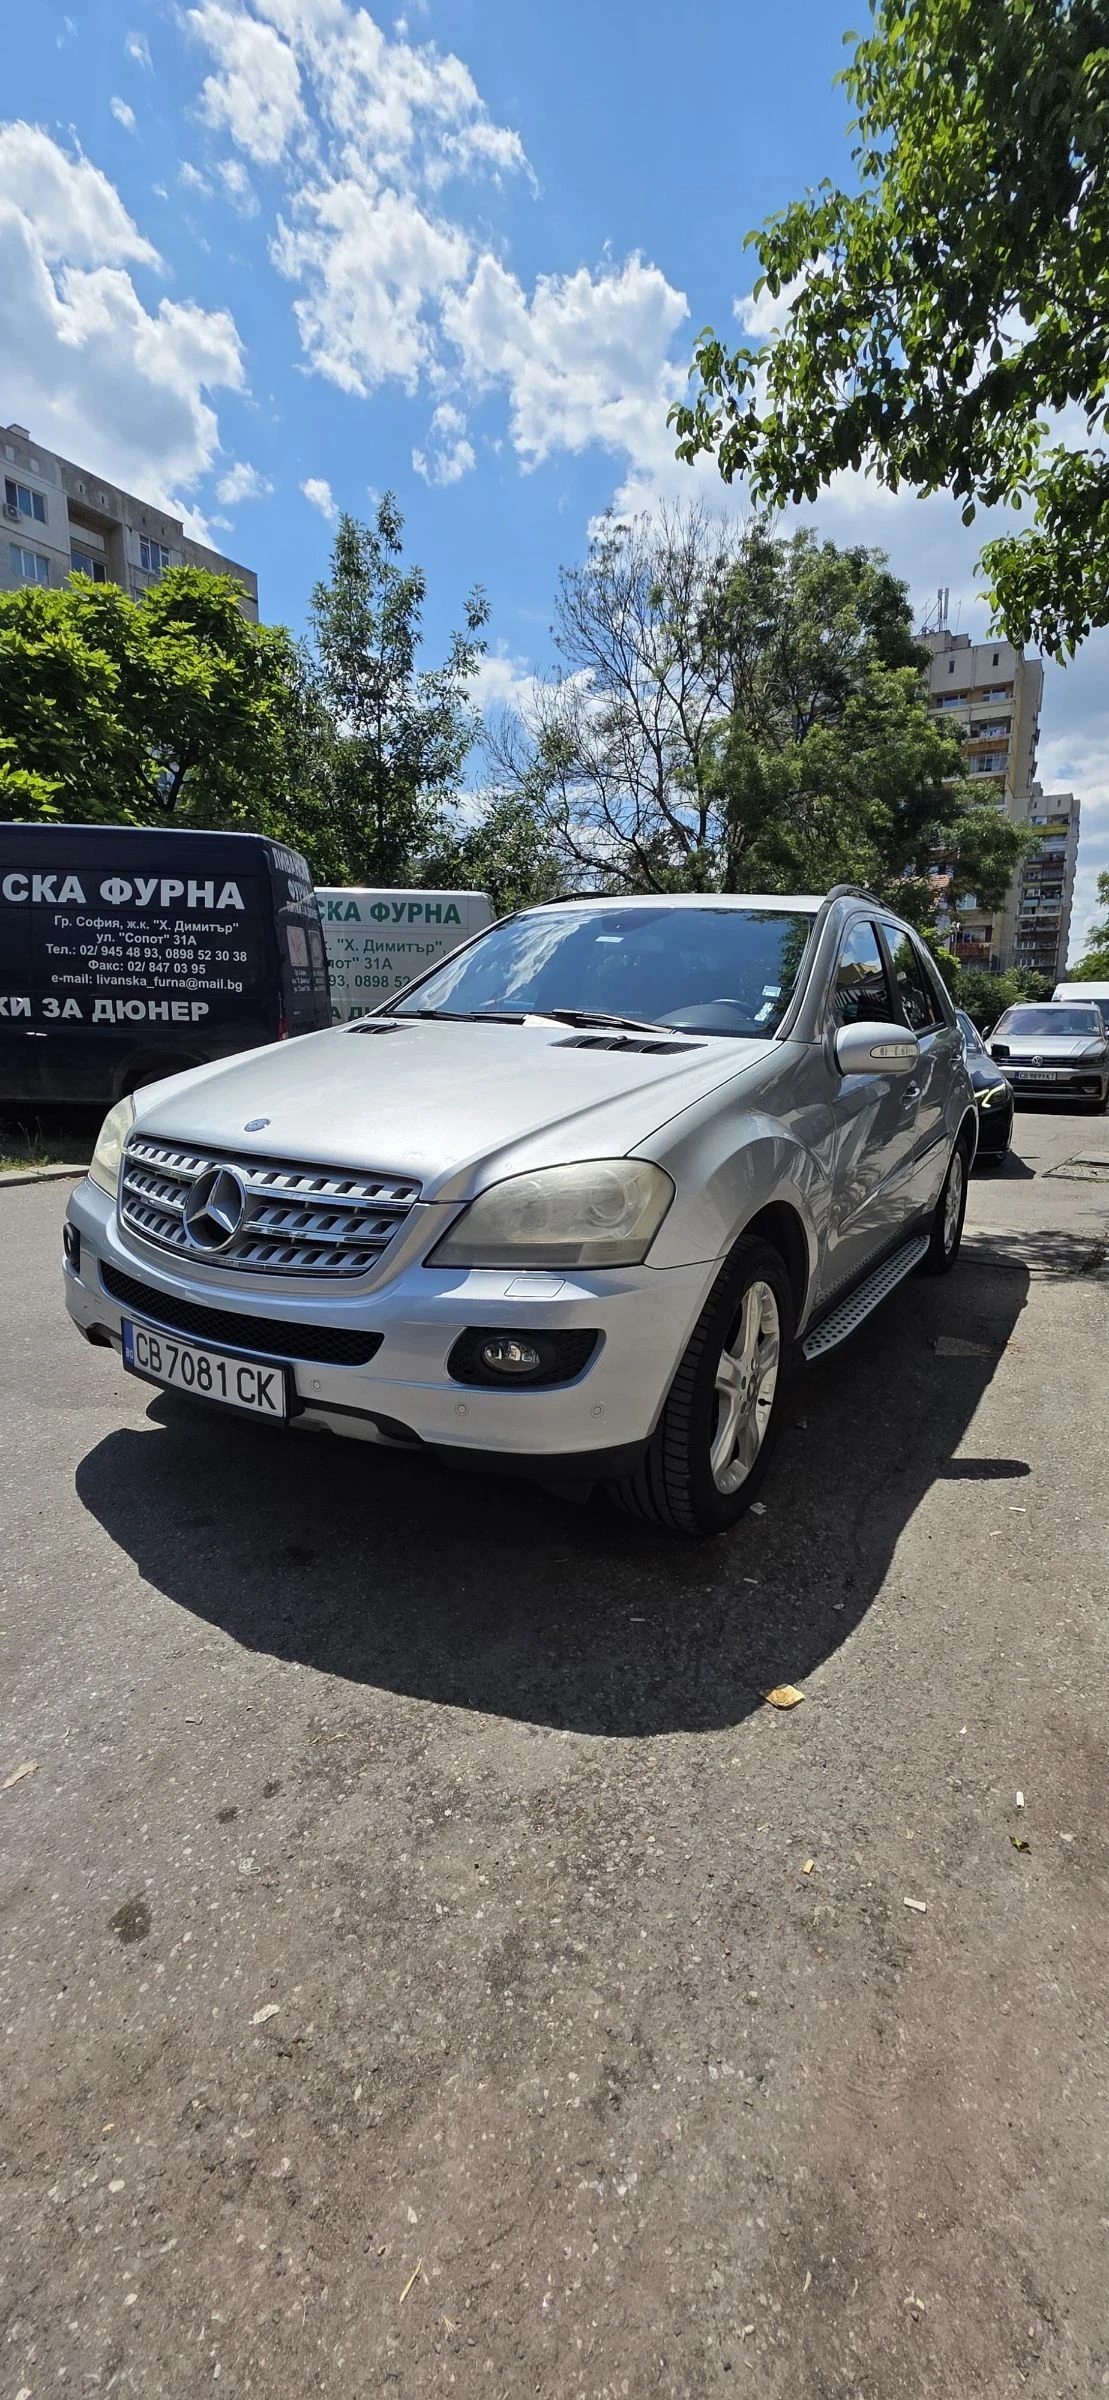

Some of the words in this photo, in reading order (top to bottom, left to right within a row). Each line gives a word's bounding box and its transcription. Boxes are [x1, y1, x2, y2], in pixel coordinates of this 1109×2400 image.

[2, 873, 87, 904] СКА
[99, 876, 246, 910] ФУРНА
[369, 902, 462, 925] ФУРНА
[54, 915, 72, 928] Гр.
[76, 916, 123, 930] София,
[126, 920, 150, 930] ж.к.
[153, 919, 171, 931] "Х.
[174, 920, 239, 935] Димитър"
[96, 932, 115, 944] ул.
[118, 932, 170, 944] "Сопот"
[173, 934, 197, 946] 31А
[337, 938, 359, 951] "Х.
[45, 943, 76, 955] Тел.:
[79, 944, 98, 956] 02/
[101, 945, 123, 957] 945
[125, 946, 141, 958] 48
[144, 947, 162, 960] 93,
[165, 948, 194, 960] 0898
[197, 949, 212, 961] 52
[215, 950, 230, 961] 30
[232, 951, 247, 962] 38
[88, 959, 124, 971] Факс:
[127, 961, 146, 972] 02/
[148, 961, 170, 973] 847
[173, 962, 188, 974] 03
[191, 963, 206, 975] 95
[364, 957, 393, 970] 31А
[51, 973, 93, 984] e-mail:
[96, 973, 243, 993] livanska_furna@mail.bg
[354, 975, 389, 988] 0898
[41, 998, 84, 1019] ЗА
[91, 999, 210, 1023] ДЮНЕР
[125, 1347, 134, 1360] BG
